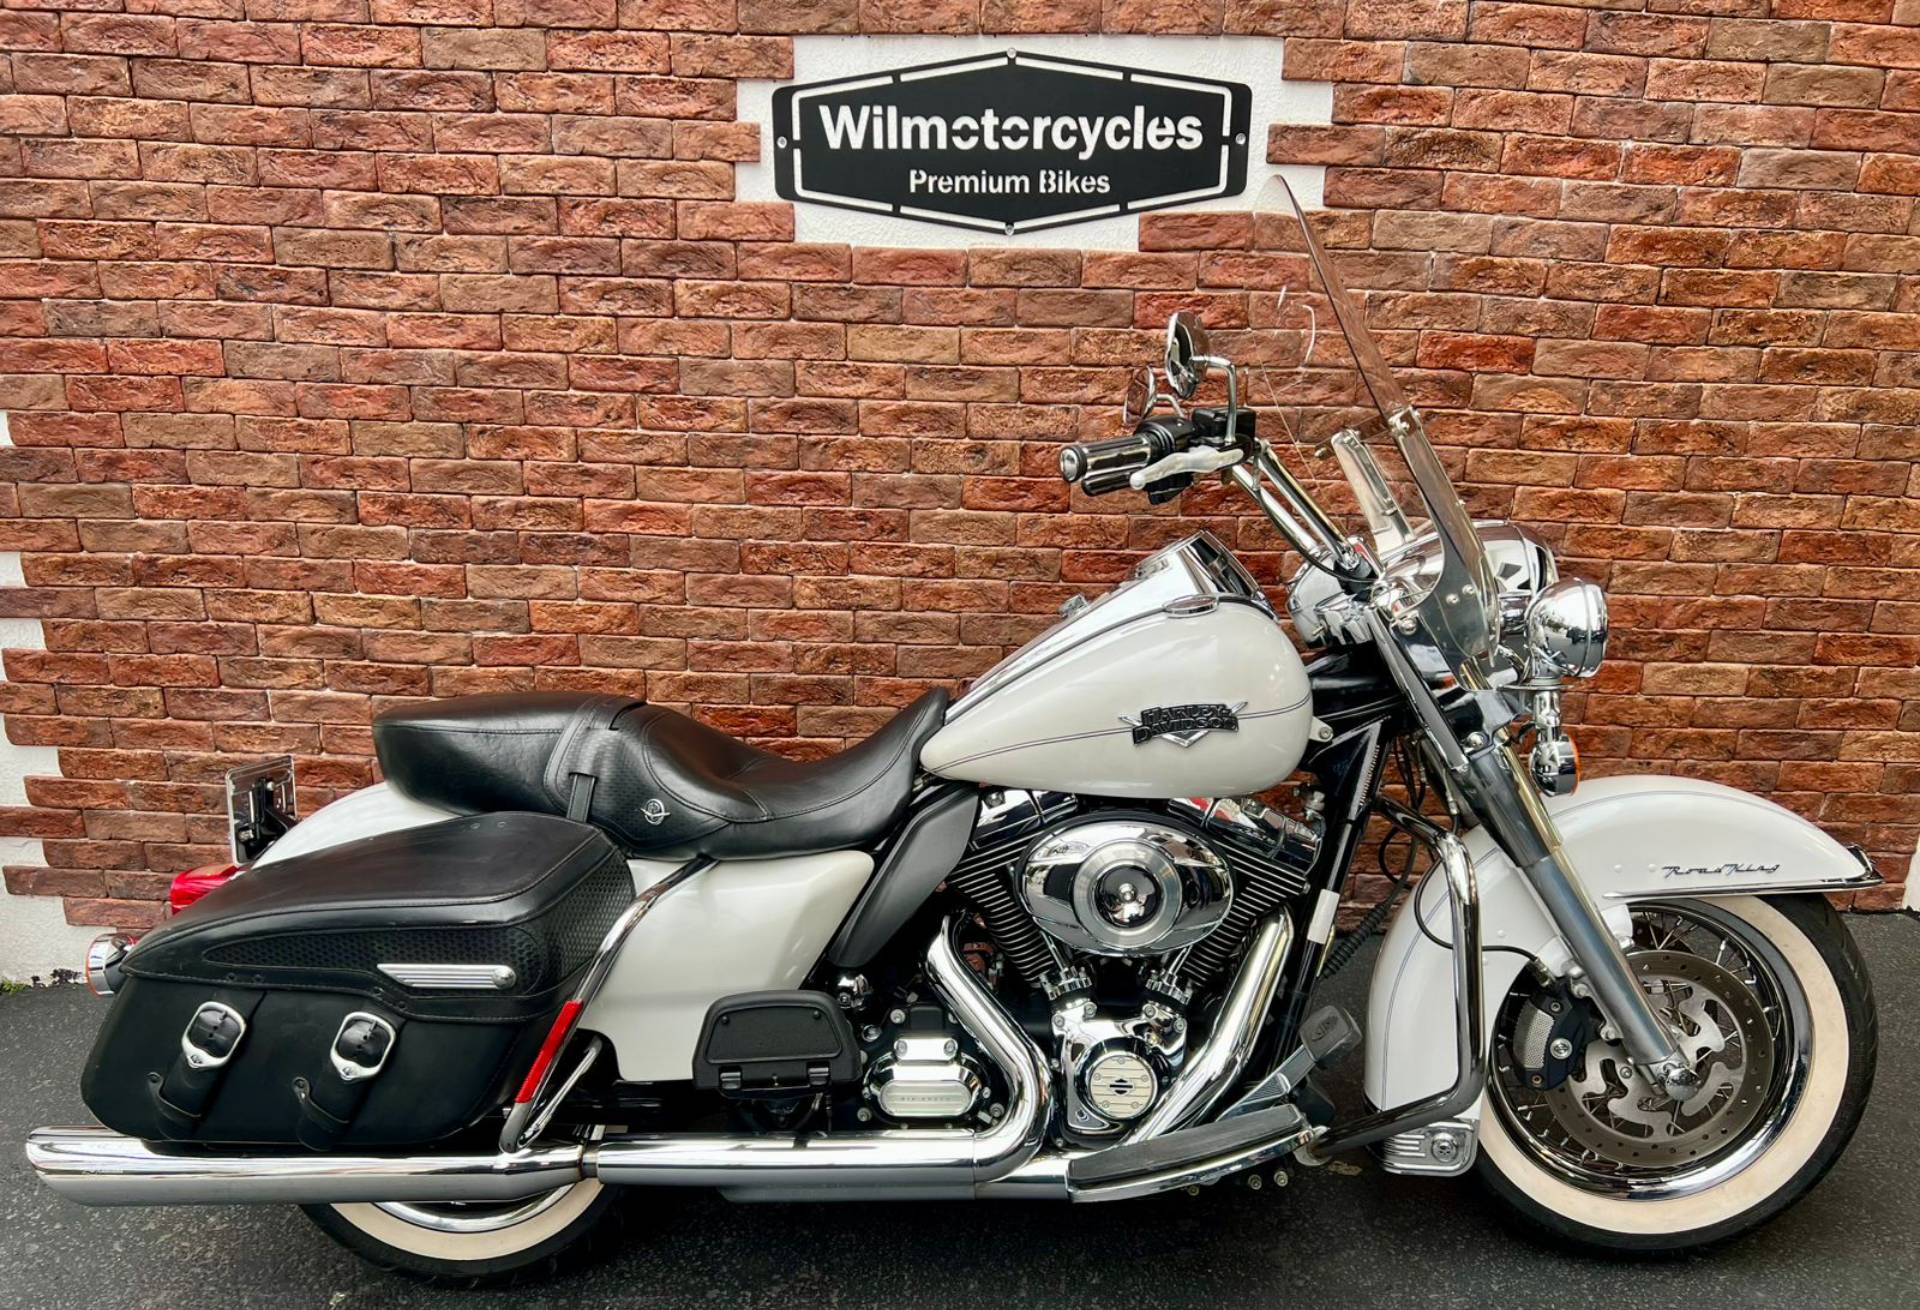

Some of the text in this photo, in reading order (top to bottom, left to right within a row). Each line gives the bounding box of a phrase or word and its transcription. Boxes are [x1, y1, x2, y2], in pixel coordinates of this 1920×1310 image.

[819, 105, 1203, 160] Wilmotorcycles
[909, 169, 1111, 194] Premium Bikes
